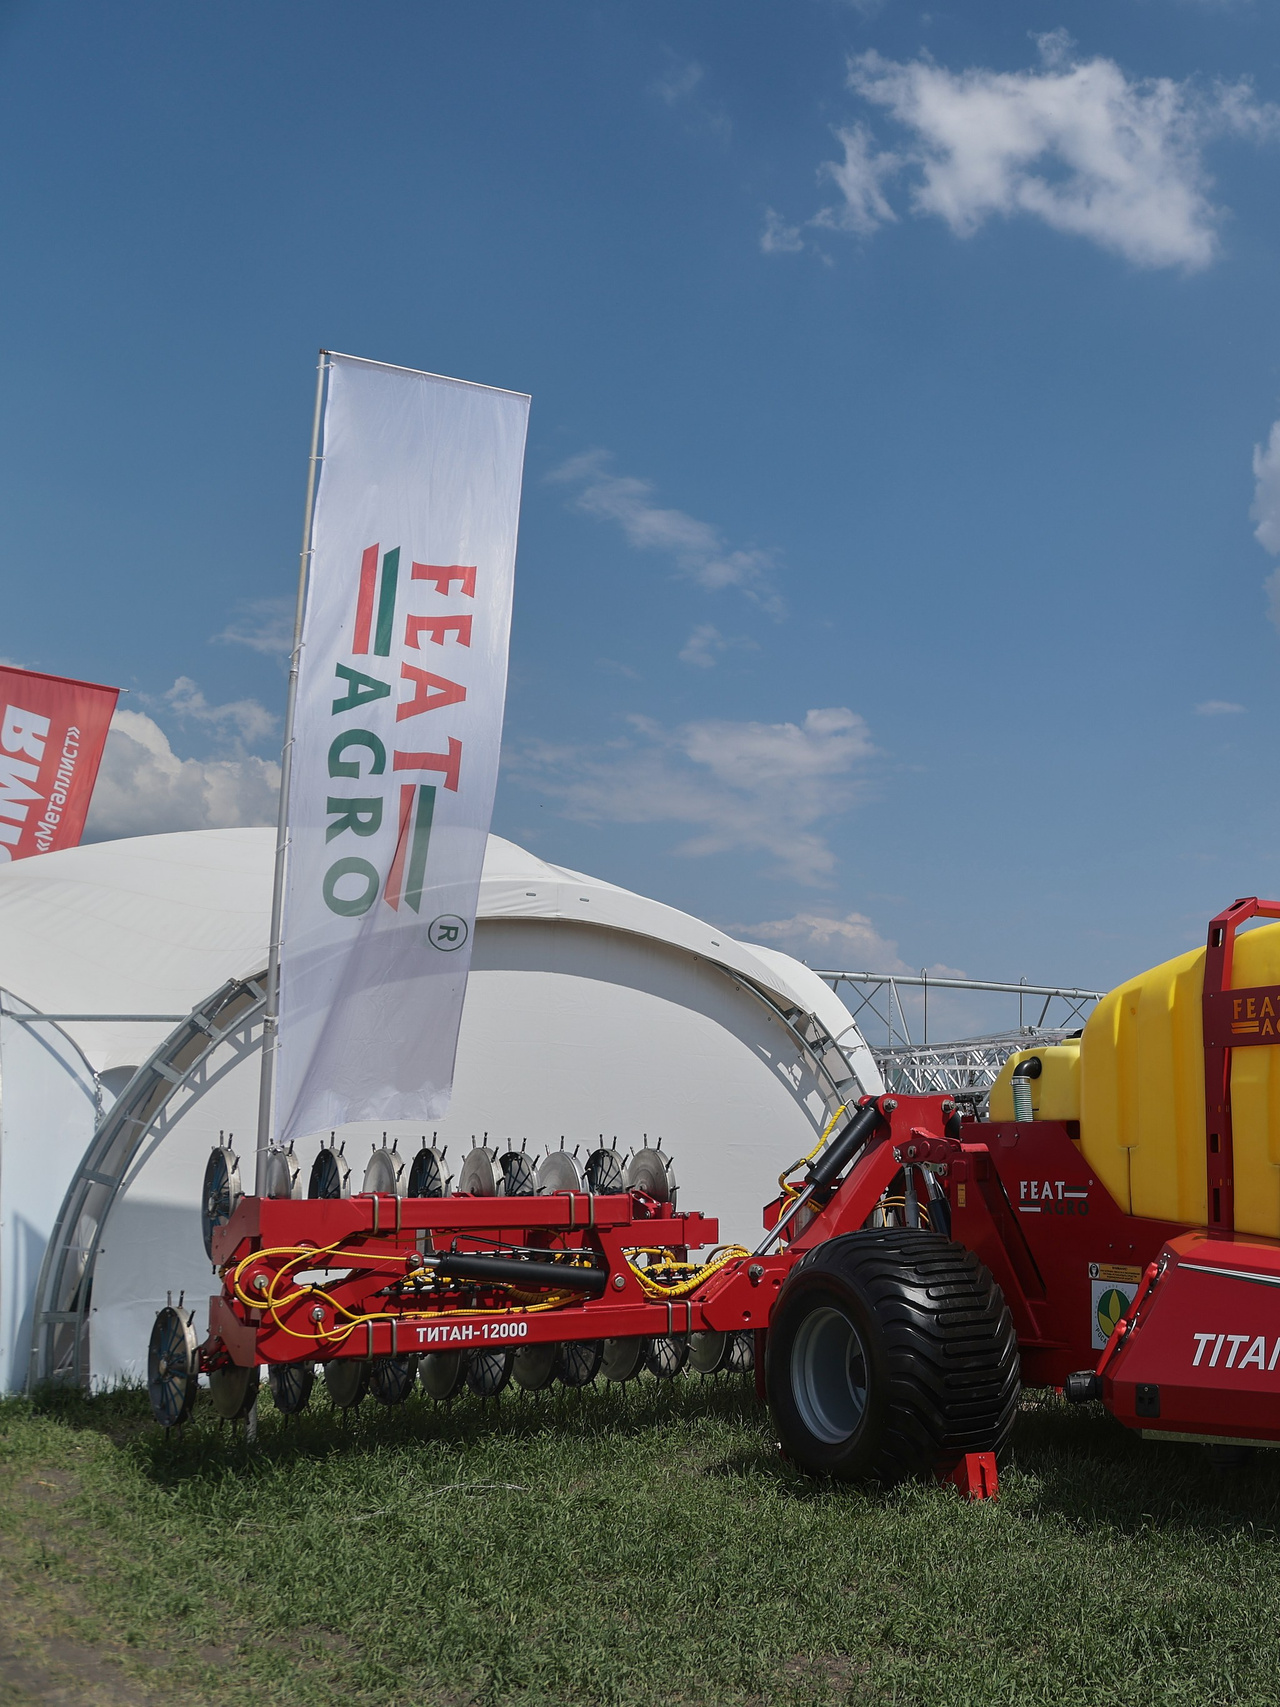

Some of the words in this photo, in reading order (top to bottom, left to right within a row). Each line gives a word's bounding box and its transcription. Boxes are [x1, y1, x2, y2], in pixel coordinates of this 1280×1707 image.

[393, 560, 478, 792] FEAT
[34, 725, 81, 852] «Металлист»
[322, 661, 392, 917] AGRO
[1020, 1181, 1065, 1200] FEAT
[1042, 1200, 1089, 1216] AGRO
[416, 1322, 528, 1343] ТИТАН-12000
